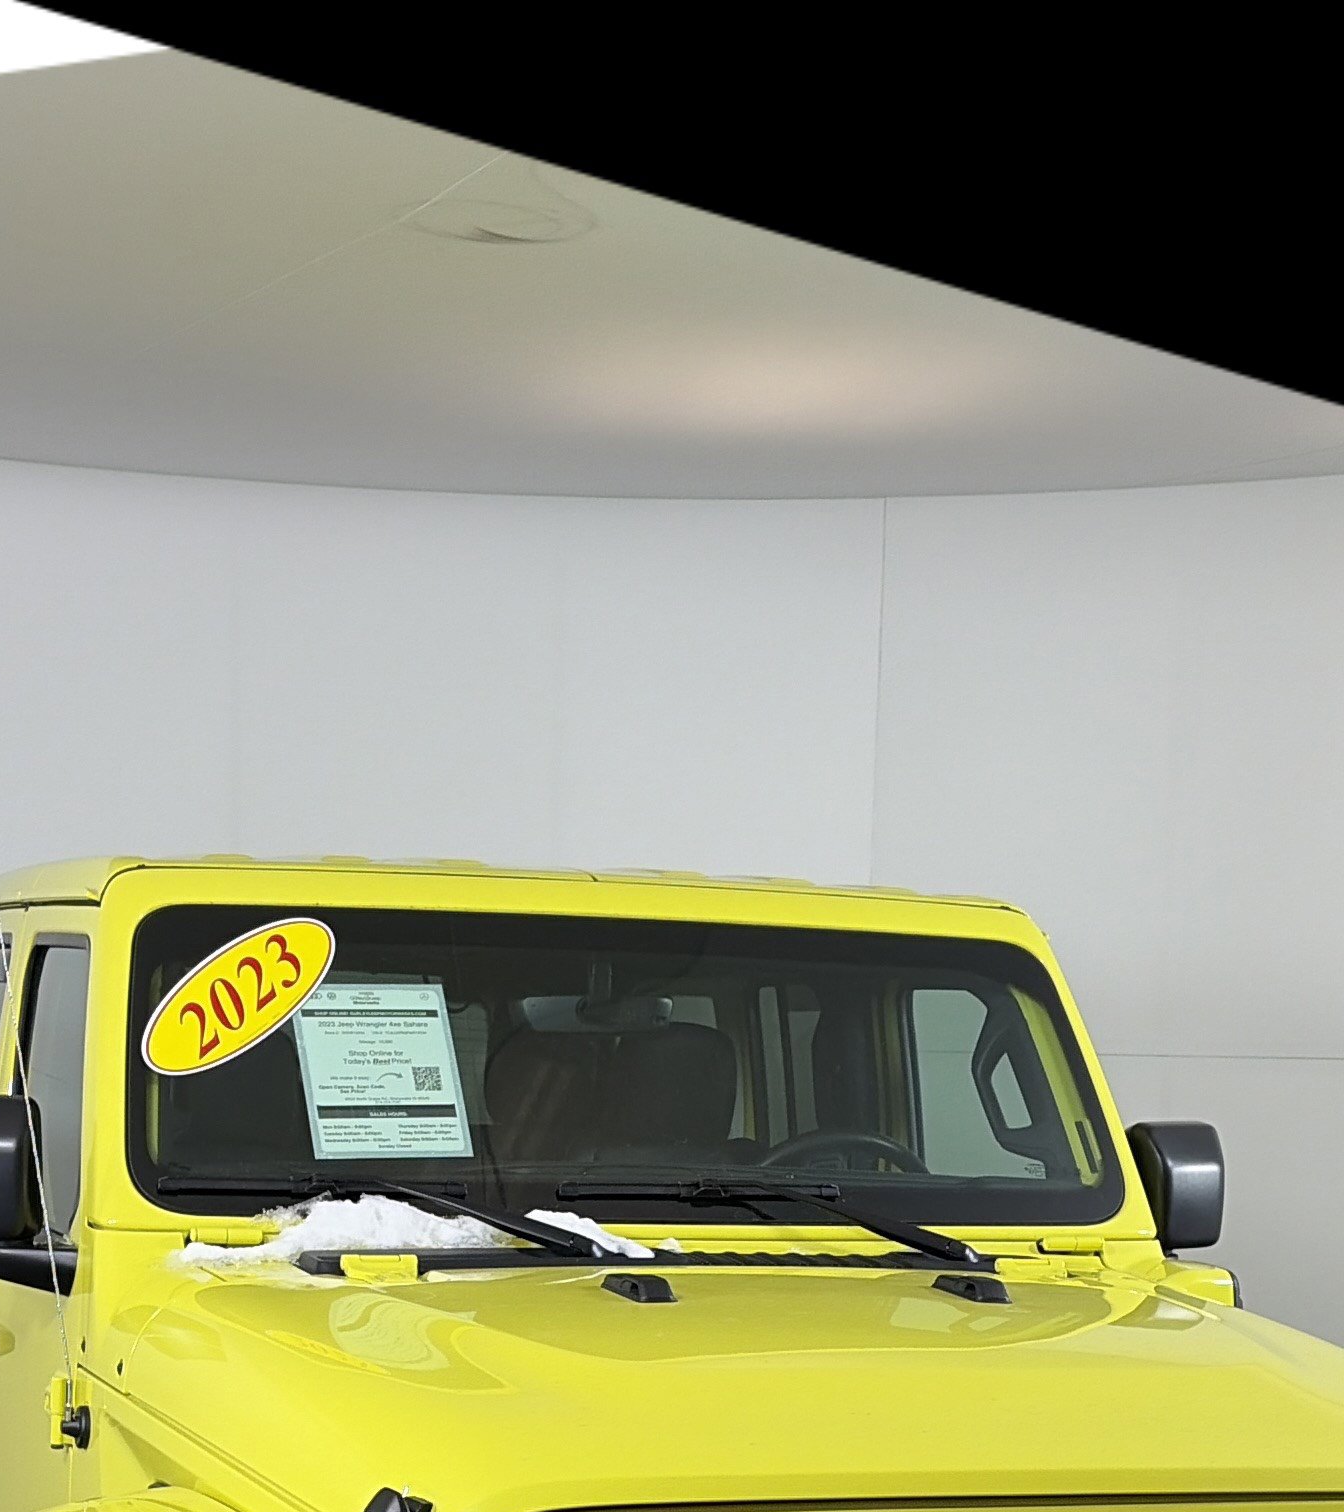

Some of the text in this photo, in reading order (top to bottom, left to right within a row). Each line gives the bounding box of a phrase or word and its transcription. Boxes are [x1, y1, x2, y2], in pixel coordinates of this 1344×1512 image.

[179, 934, 302, 1060] 2023
[338, 1021, 354, 1029] Jeep
[355, 1021, 387, 1029] Wrangler
[348, 1050, 368, 1058] Shop
[343, 1058, 371, 1066] Today's
